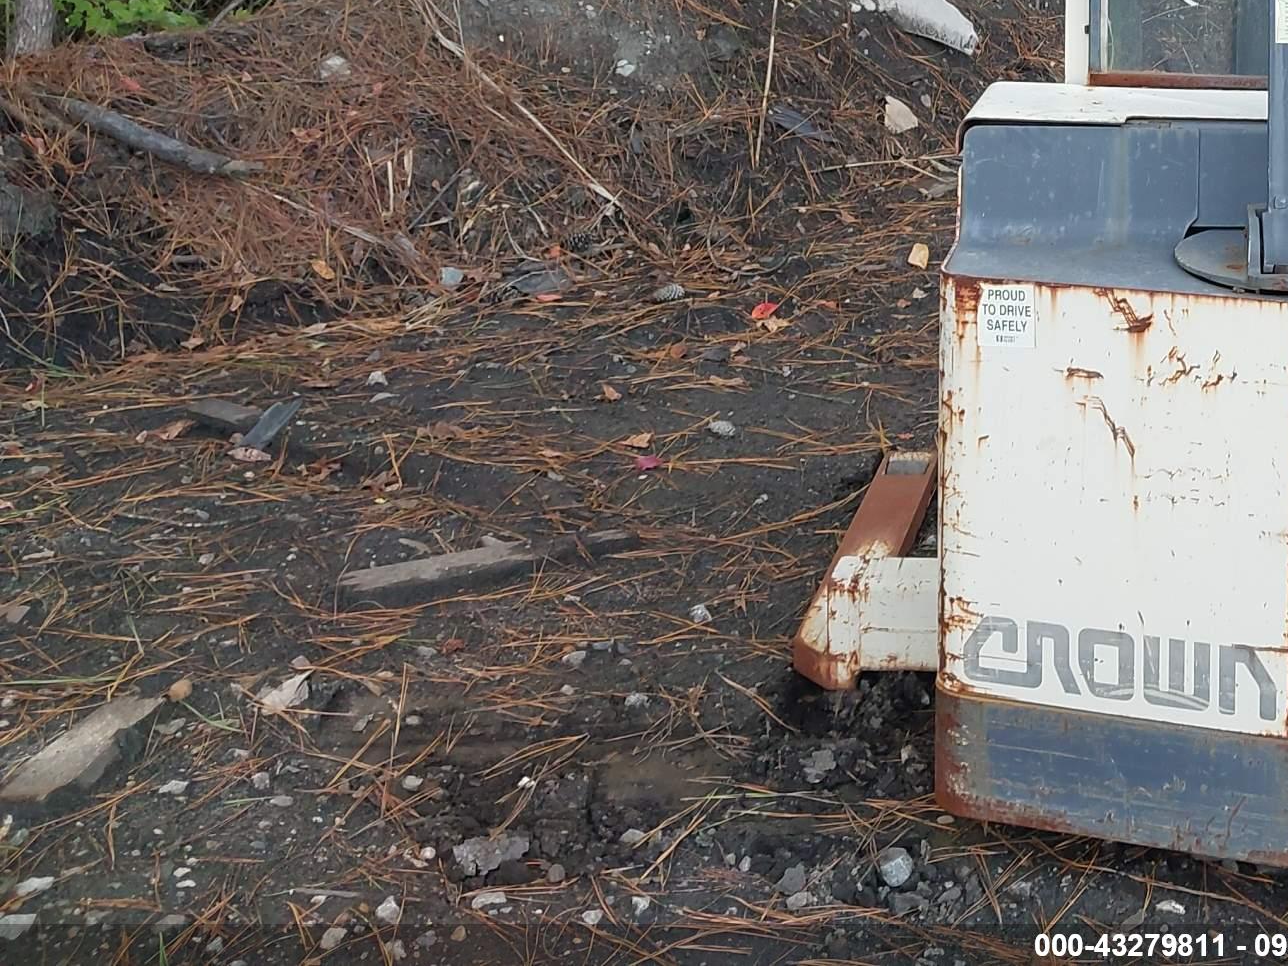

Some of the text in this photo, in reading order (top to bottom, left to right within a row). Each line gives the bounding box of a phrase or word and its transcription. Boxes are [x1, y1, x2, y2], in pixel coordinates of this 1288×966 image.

[987, 289, 1025, 302] PROUD
[982, 303, 1031, 317] TO DRIVE
[986, 319, 1027, 332] SAFELY
[963, 616, 1277, 722] CROWN
